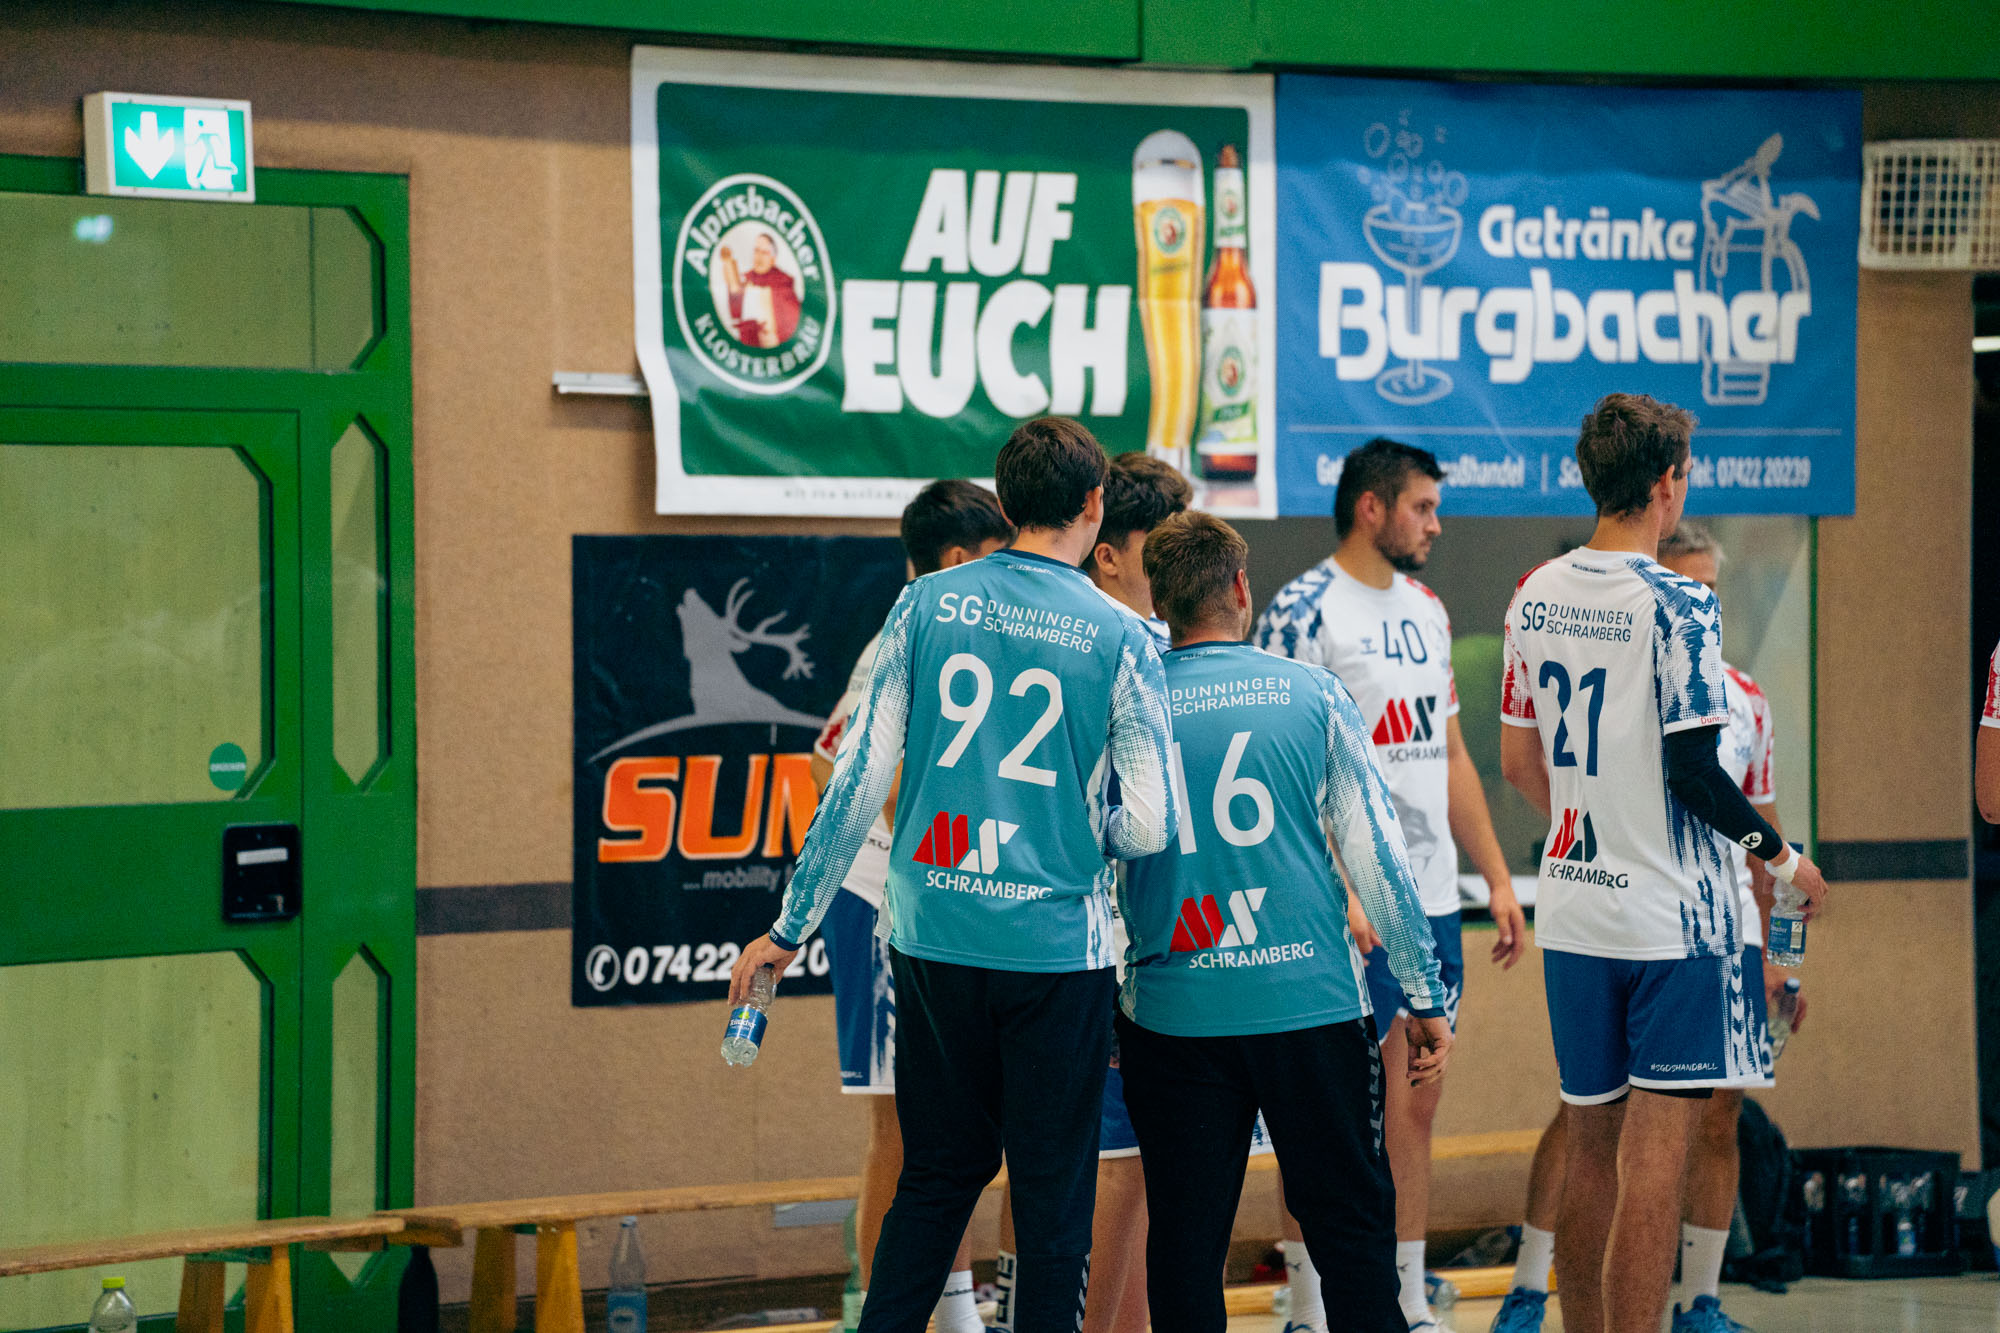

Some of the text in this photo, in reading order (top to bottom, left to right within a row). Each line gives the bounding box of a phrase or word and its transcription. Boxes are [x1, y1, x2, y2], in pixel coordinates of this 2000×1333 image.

[685, 185, 820, 281] Alpirsbacher
[902, 168, 1077, 276] AUF
[1478, 204, 1697, 261] Getränke
[1319, 262, 1811, 384] Burgbacher
[842, 279, 1132, 418] EUCH
[935, 592, 1099, 638] SG DUNNINGEN
[983, 617, 1093, 654] SCHRAMBERG
[1521, 601, 1633, 631] SG DUNNINGEN
[1546, 620, 1632, 643] SCHRAMBERG
[1382, 619, 1428, 666] 40
[1171, 677, 1291, 702] DUNNINGEN
[1171, 691, 1291, 717] SCHRAMBERG
[936, 653, 1063, 787] 92
[1539, 660, 1607, 777] 21
[1171, 731, 1275, 855] 16
[925, 869, 1053, 901] SCHRAMBERG
[623, 942, 741, 985] 07422
[1188, 940, 1314, 969] SCHRAMBERG
